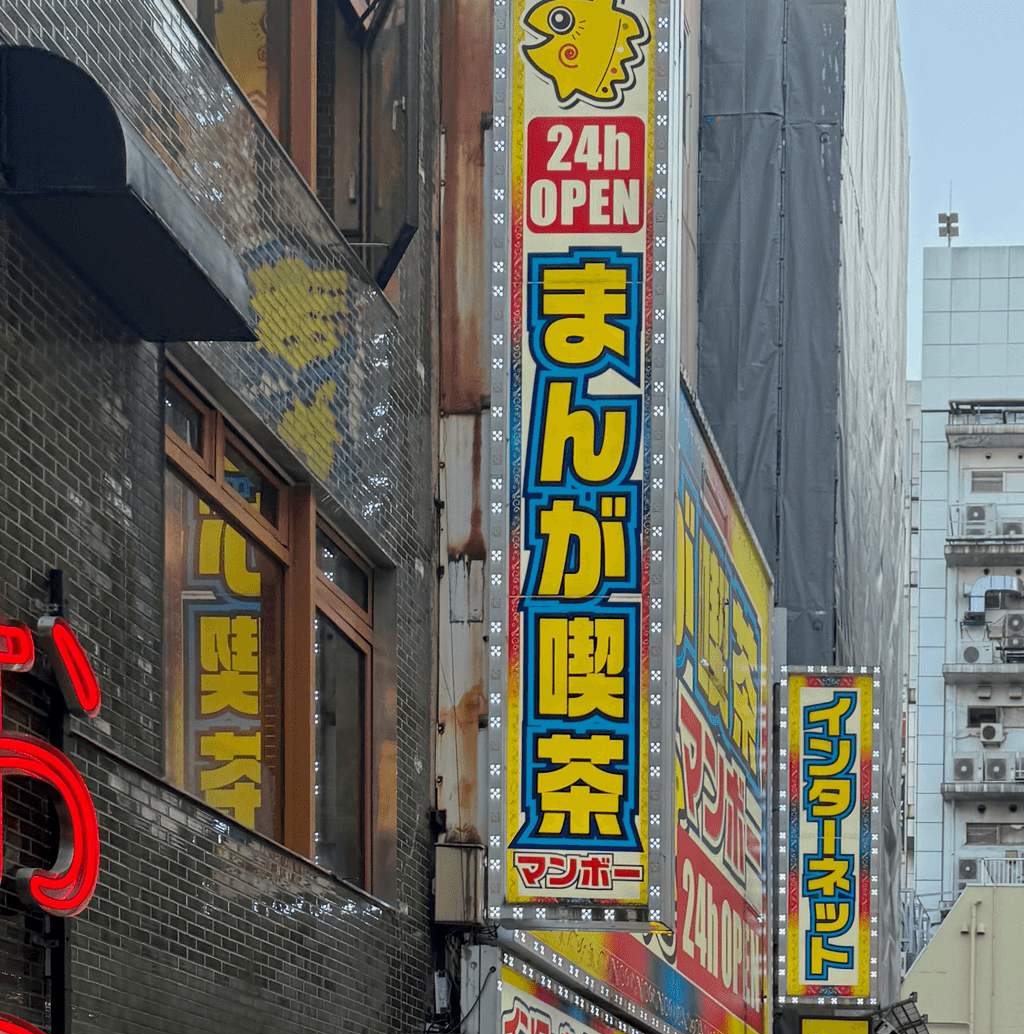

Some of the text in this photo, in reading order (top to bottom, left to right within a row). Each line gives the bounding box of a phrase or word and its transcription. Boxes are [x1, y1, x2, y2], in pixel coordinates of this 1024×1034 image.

[546, 124, 631, 171] 24h
[530, 179, 640, 226] OPEN
[534, 255, 632, 838] まんが喫茶
[516, 854, 643, 889] マンボー
[806, 694, 855, 980] インターネット
[681, 858, 761, 1013] 24h OPEN
